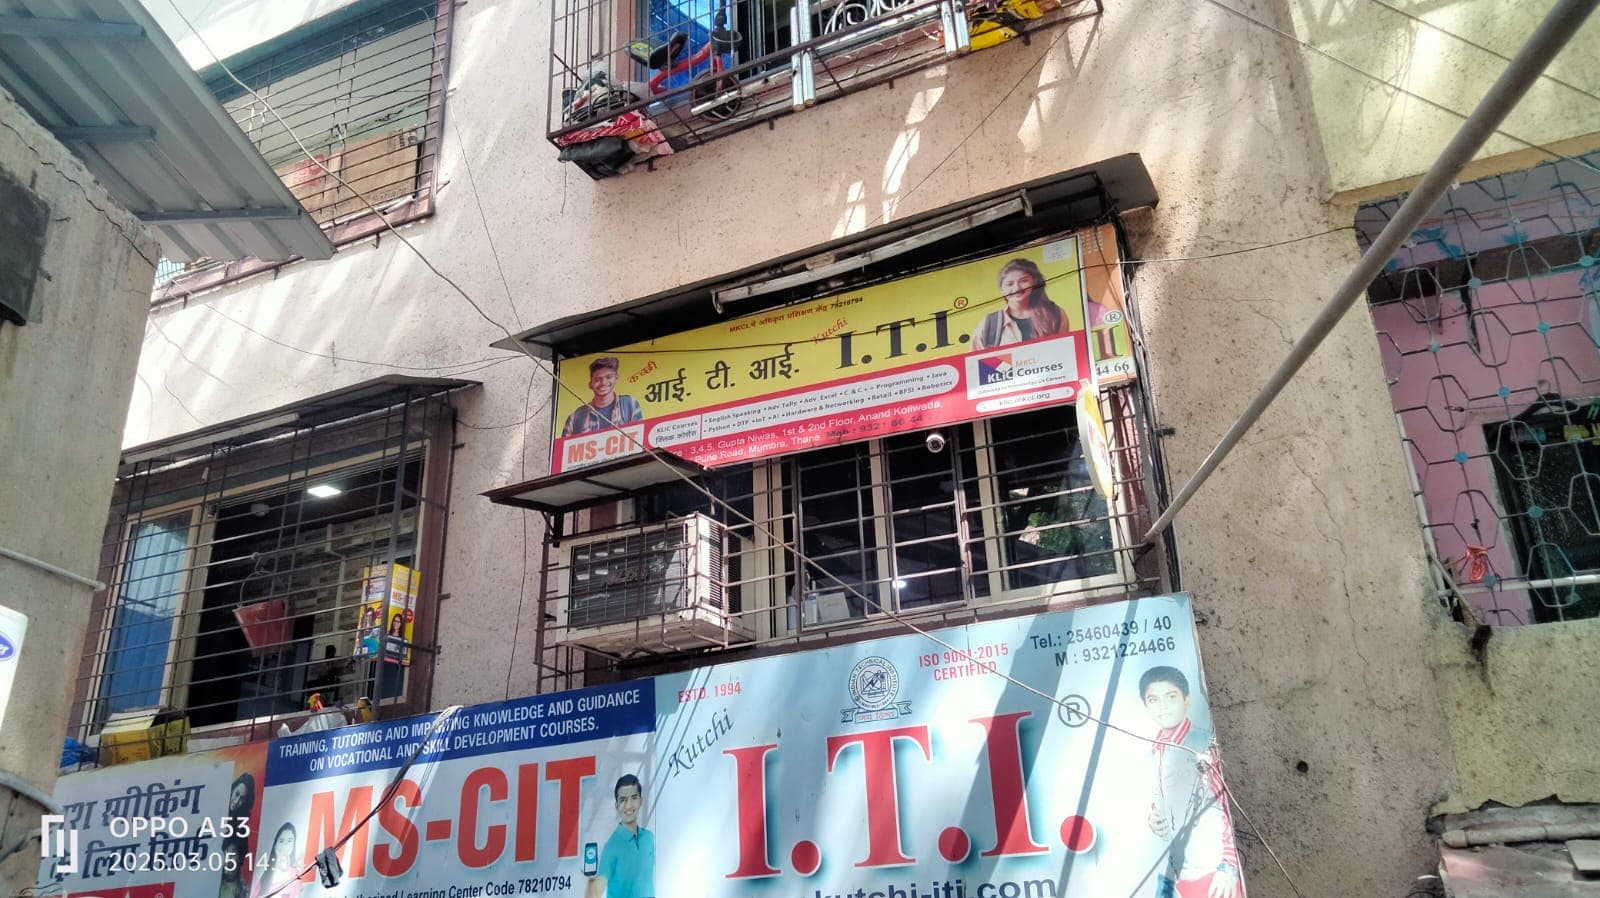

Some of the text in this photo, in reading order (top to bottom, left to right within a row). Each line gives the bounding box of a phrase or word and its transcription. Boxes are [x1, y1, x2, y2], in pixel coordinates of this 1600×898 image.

[812, 317, 848, 344] Kutchi
[835, 309, 971, 371] I.T.I.
[644, 344, 801, 404] आई. टी. आई.
[1017, 361, 1064, 377] Courses
[1115, 360, 1130, 372] 66
[708, 415, 731, 426] English
[732, 409, 762, 421] Speaking
[876, 376, 924, 392] Programming
[932, 371, 948, 380] Java
[709, 423, 731, 435] Python
[786, 406, 818, 418] Hardware
[825, 396, 865, 410] Networking
[871, 392, 892, 401] Retail
[921, 381, 953, 393] Robotics
[672, 421, 698, 431] Courses
[718, 437, 746, 450] Gupta
[782, 427, 796, 437] 1st
[798, 425, 806, 434] &
[808, 420, 826, 433] 2nd
[858, 406, 891, 421] Anand
[567, 431, 640, 465] MS-CIT
[1066, 620, 1139, 645] 25460439
[1153, 616, 1172, 632] 40
[919, 643, 1010, 668] ISO 9001:2015
[1055, 653, 1068, 667] M
[1082, 637, 1176, 663] 9321224466
[933, 661, 997, 682] CERTIFIED
[676, 681, 743, 705] ESTD. 1994
[280, 740, 329, 759] TRAINING,
[332, 731, 382, 750] TUTORING
[386, 725, 409, 741] AND
[474, 705, 544, 728] KNOWLEDGE
[547, 700, 574, 717] AND
[577, 689, 641, 712] GUIDANCE
[309, 717, 600, 772] ON VOCATIONAL AND SKILL DEVELOPMENT COURSES.
[668, 708, 735, 778] Kutchi
[722, 711, 1096, 879] I.T.I.
[303, 755, 597, 883] MS-CIT
[448, 883, 483, 898] Center
[485, 880, 516, 897] Code
[518, 876, 572, 895] 78210794
